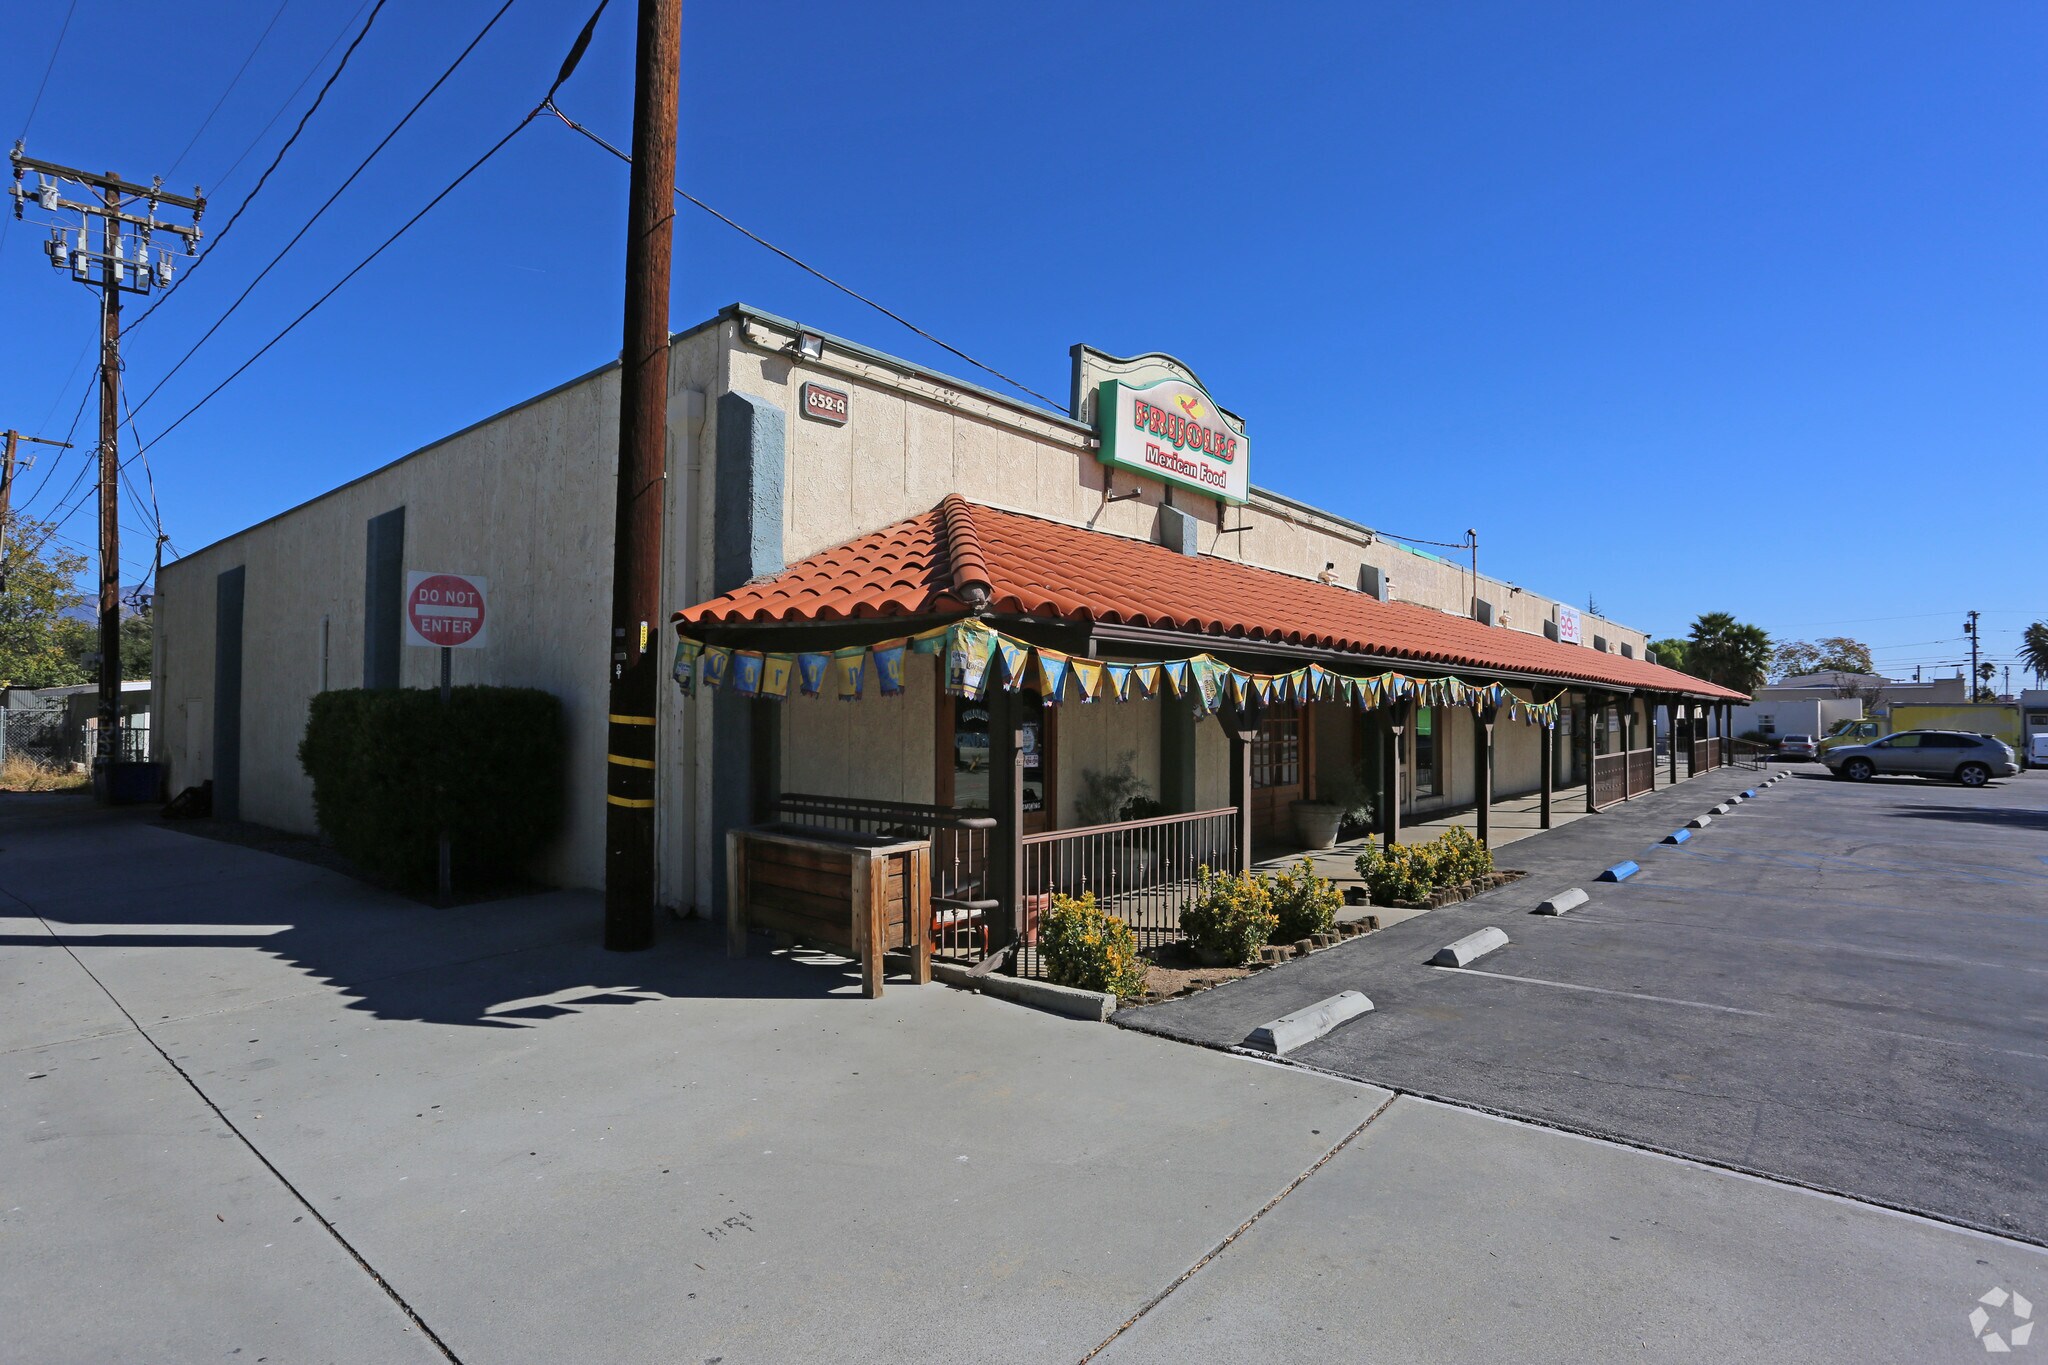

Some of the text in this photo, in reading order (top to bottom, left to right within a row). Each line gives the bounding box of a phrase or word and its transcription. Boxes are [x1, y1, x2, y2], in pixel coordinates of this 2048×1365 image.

[809, 392, 845, 414] 652-A
[1134, 399, 1237, 464] FRIJOLES
[1145, 442, 1227, 488] Mexican Food
[419, 589, 475, 605] DO NOT
[421, 618, 472, 634] ENTER
